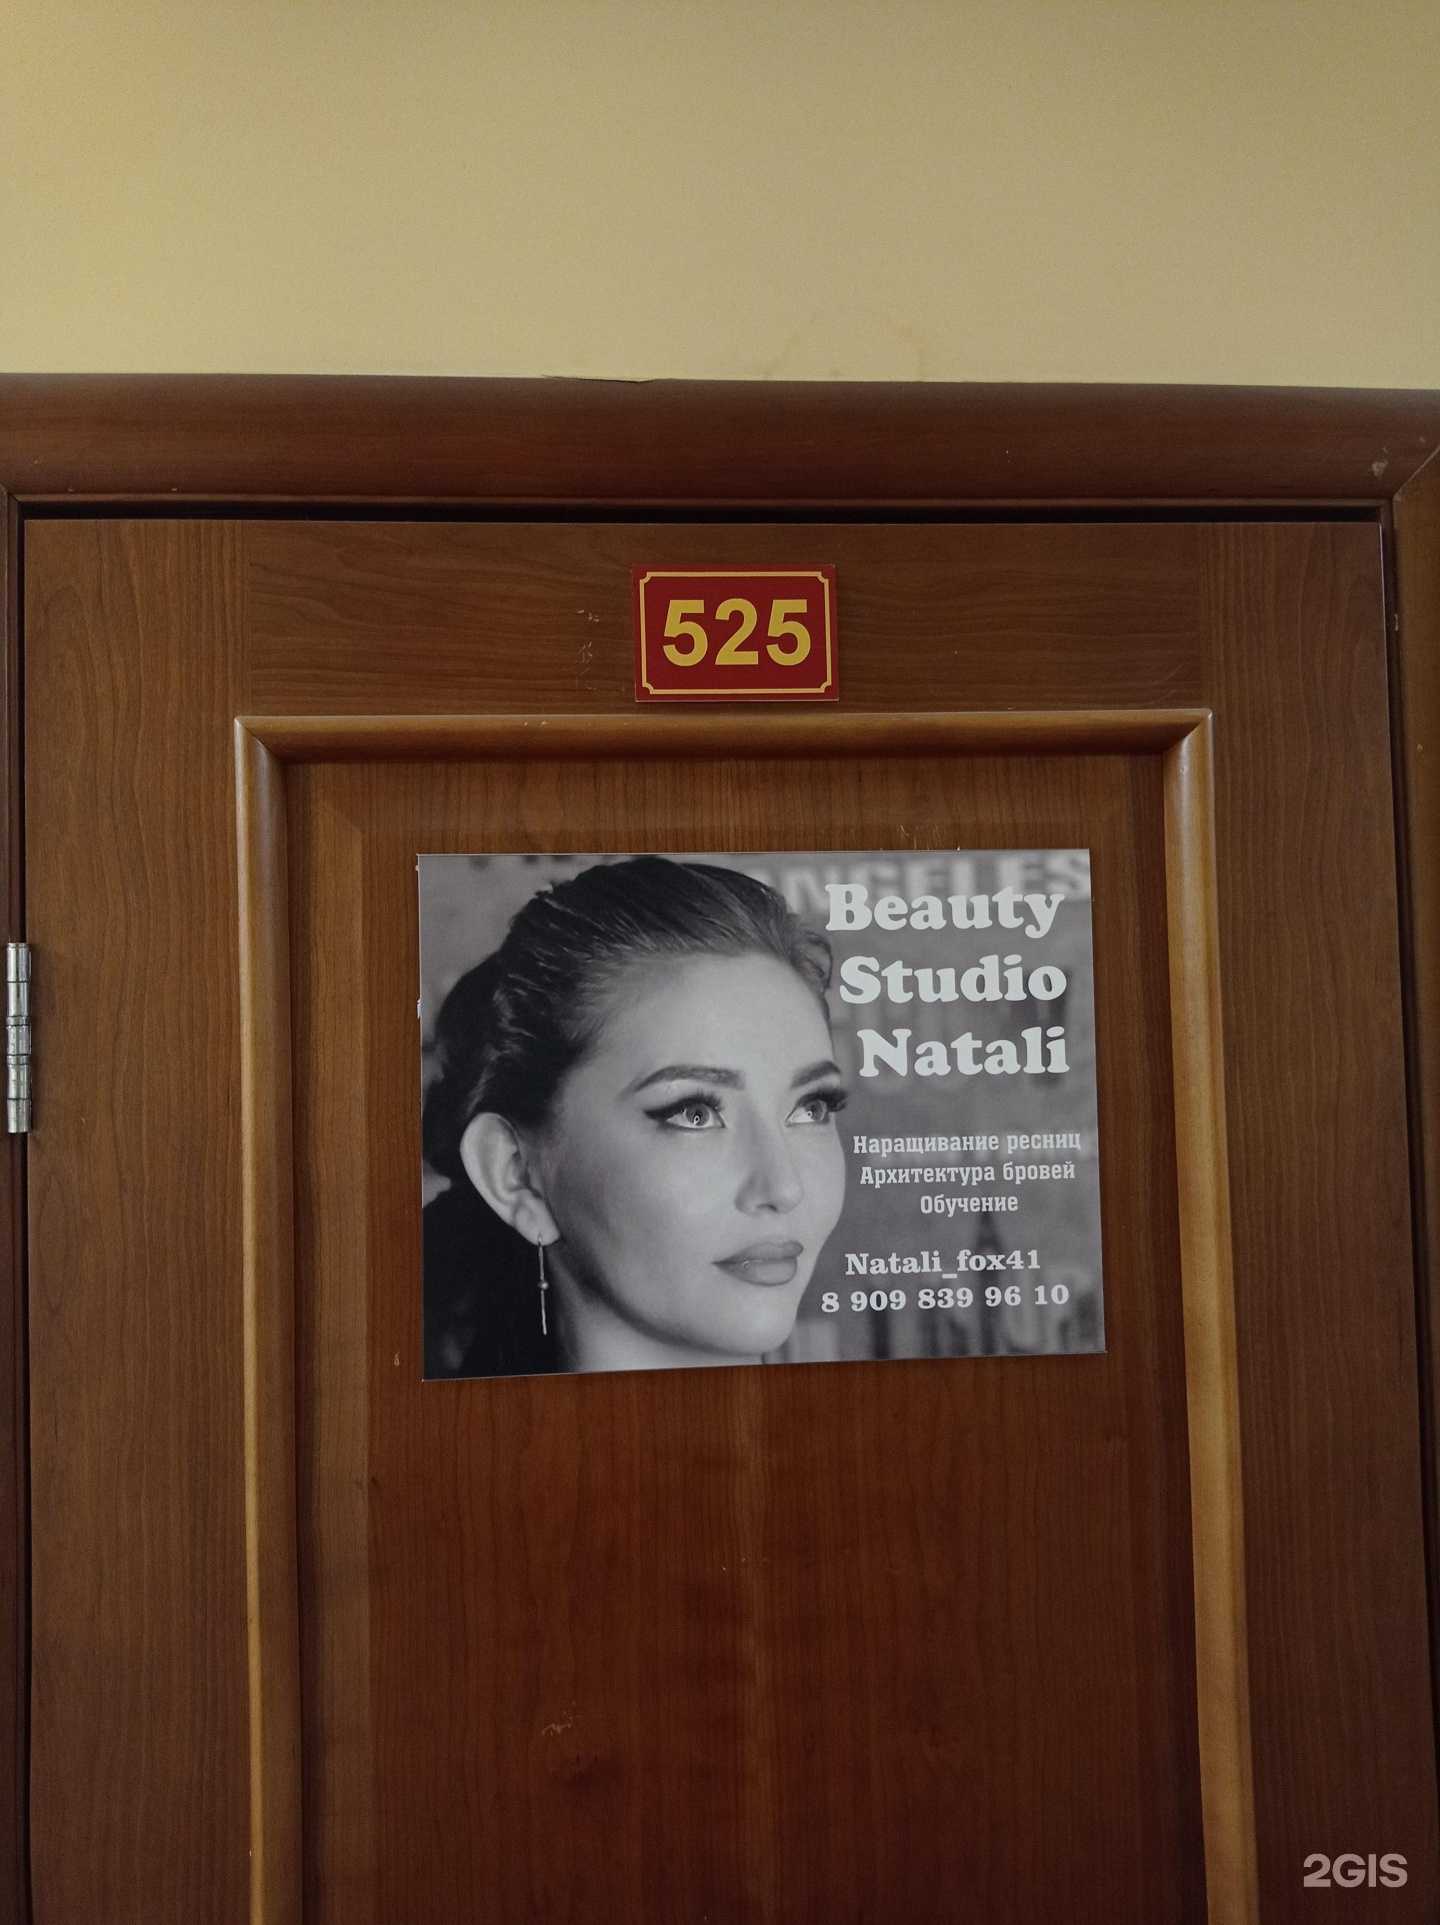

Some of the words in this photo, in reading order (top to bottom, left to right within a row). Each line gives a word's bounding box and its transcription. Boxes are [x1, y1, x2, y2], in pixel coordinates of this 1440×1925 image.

[662, 597, 811, 667] 525
[825, 883, 1066, 939] Beauty
[839, 954, 1068, 1005] Studio
[856, 1026, 1070, 1078] Natali
[853, 1134, 1000, 1158] Наращивание
[1007, 1132, 1081, 1154] ресниц
[860, 1163, 995, 1189] Архитектура
[1002, 1160, 1076, 1185] бровей
[920, 1194, 1019, 1218] Обучение
[845, 1249, 1041, 1280] Natali_fox41
[820, 1292, 840, 1313] 8
[850, 1289, 907, 1312] 909
[917, 1287, 974, 1310] 839
[984, 1285, 1022, 1308] 96
[1034, 1284, 1070, 1306] 10
